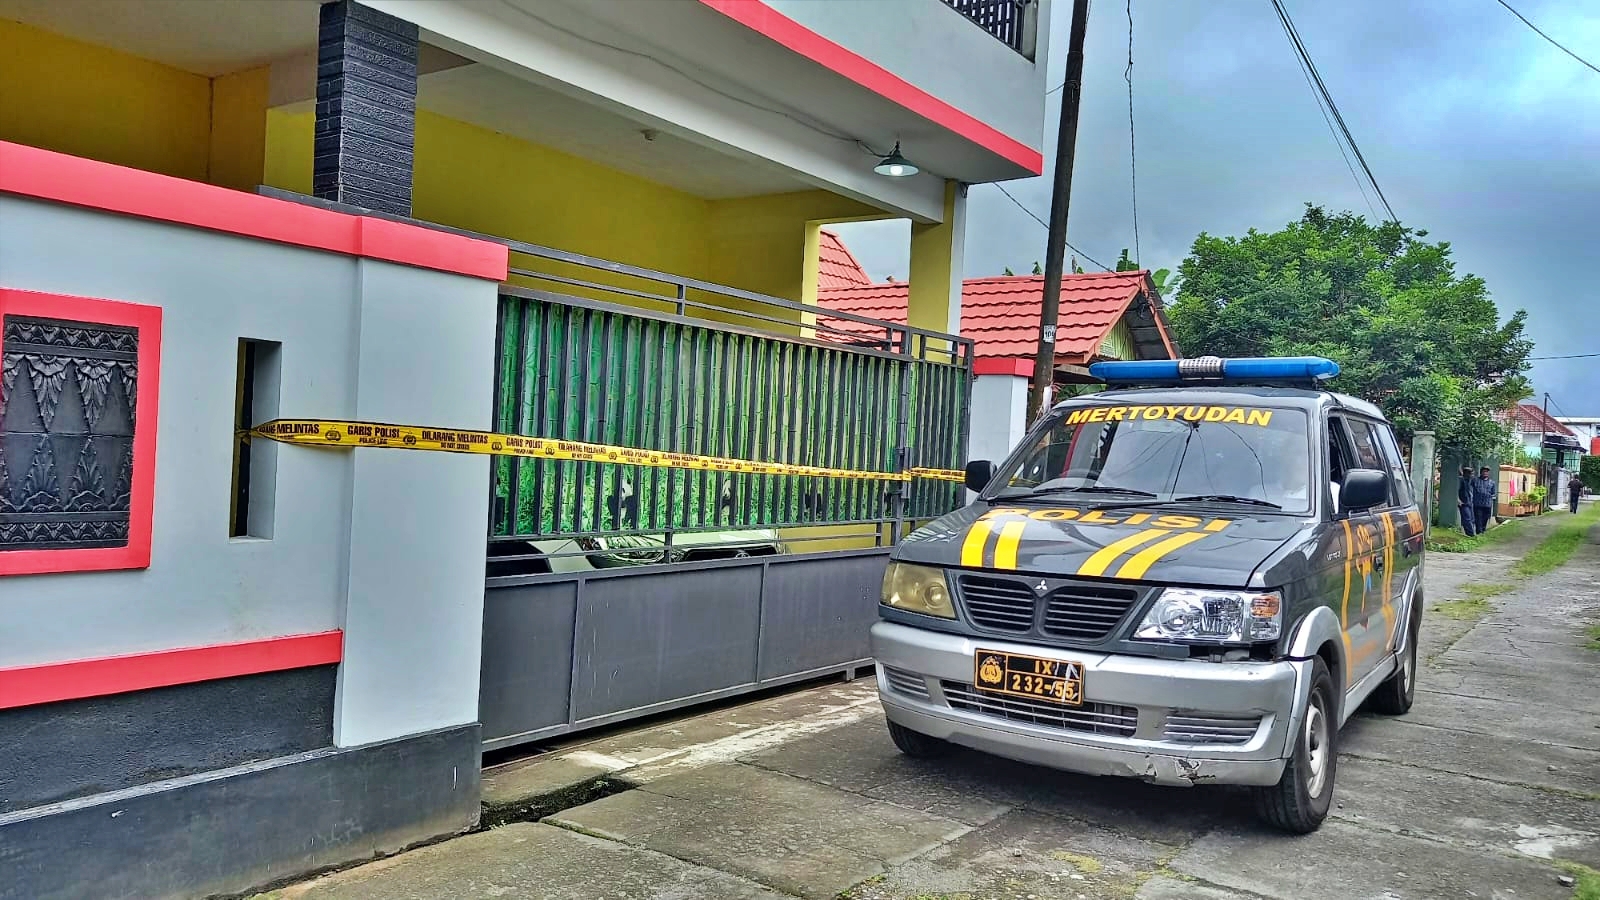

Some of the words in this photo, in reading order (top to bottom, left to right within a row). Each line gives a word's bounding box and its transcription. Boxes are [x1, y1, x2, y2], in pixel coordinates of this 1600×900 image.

[1065, 405, 1273, 427] MERTOYUDAN
[277, 423, 319, 434] MELINTAS
[347, 425, 373, 437] GARIS
[374, 426, 400, 438] POLISI
[422, 430, 455, 442] DILARANG
[457, 432, 488, 444] MELINTAS
[977, 507, 1233, 533] POLISI
[1012, 673, 1076, 699] 232-55
